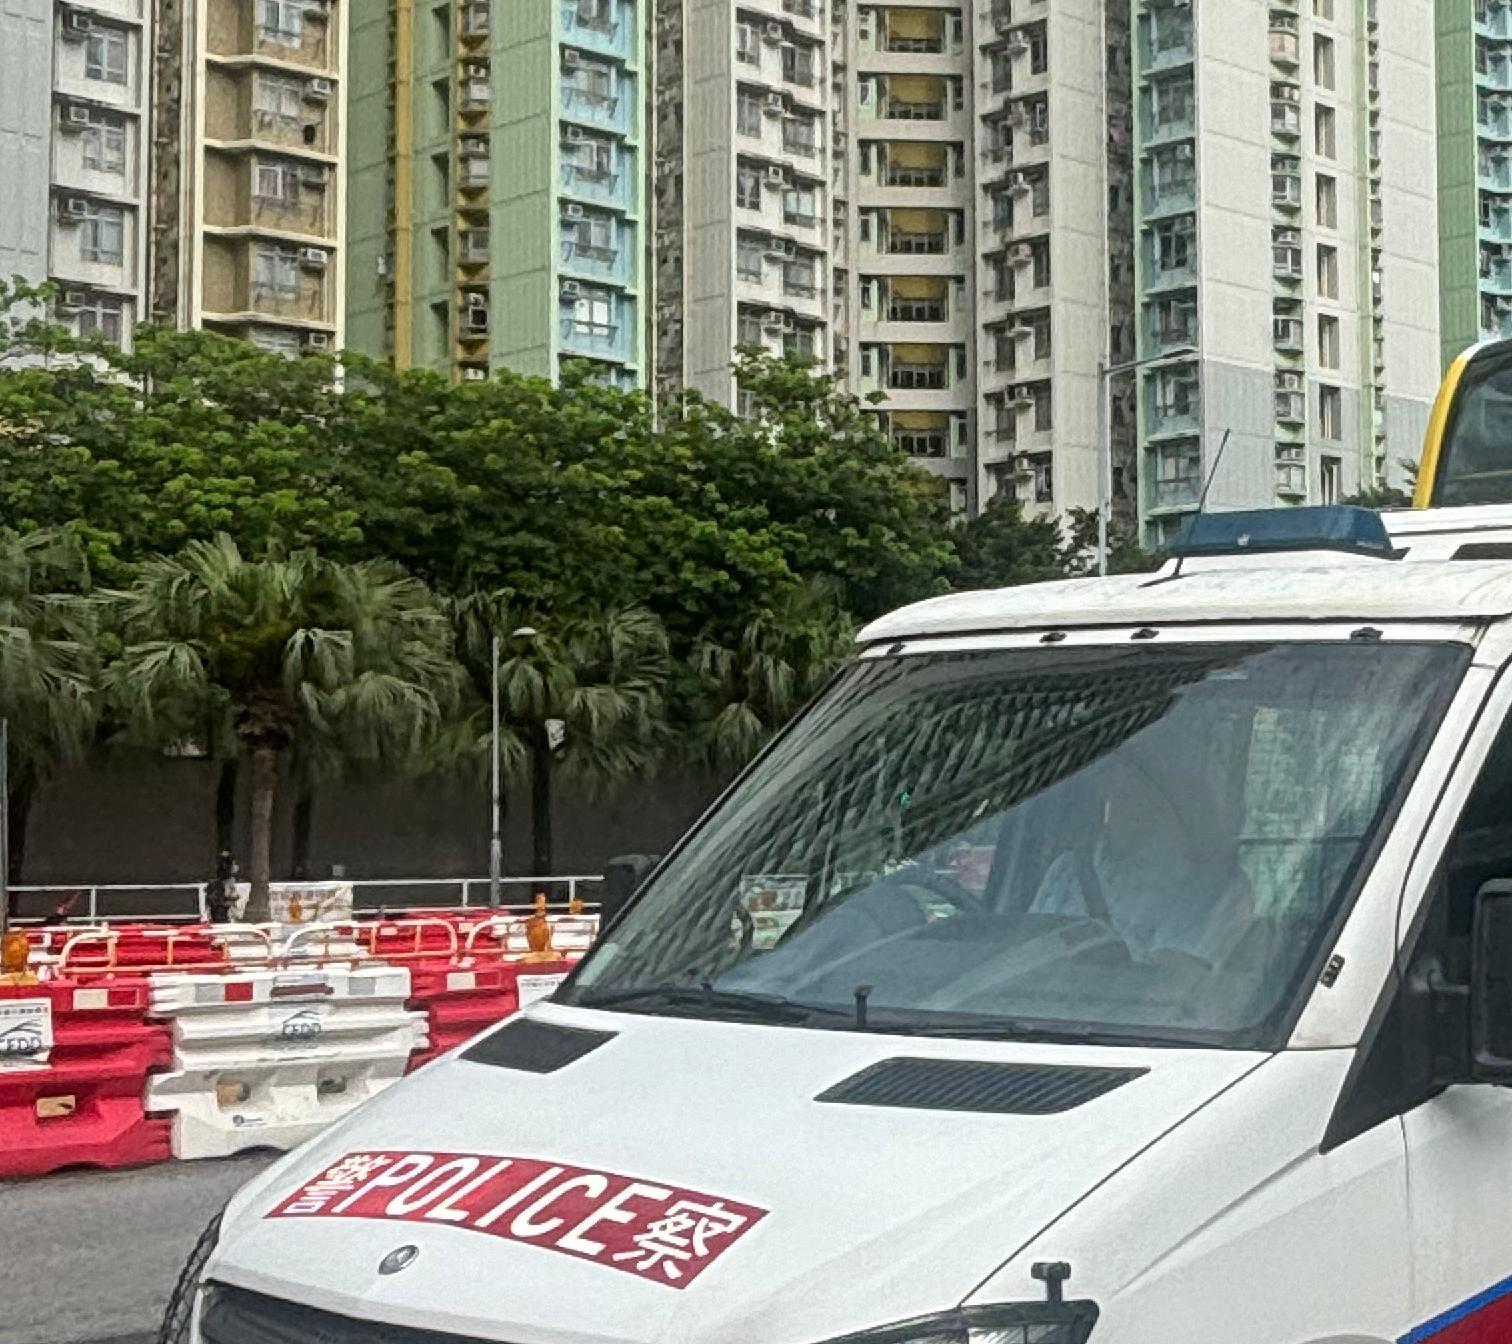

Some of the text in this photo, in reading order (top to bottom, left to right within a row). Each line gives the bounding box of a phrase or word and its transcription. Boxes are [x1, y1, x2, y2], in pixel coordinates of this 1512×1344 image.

[283, 1154, 750, 1280] 警 POLICE 察
